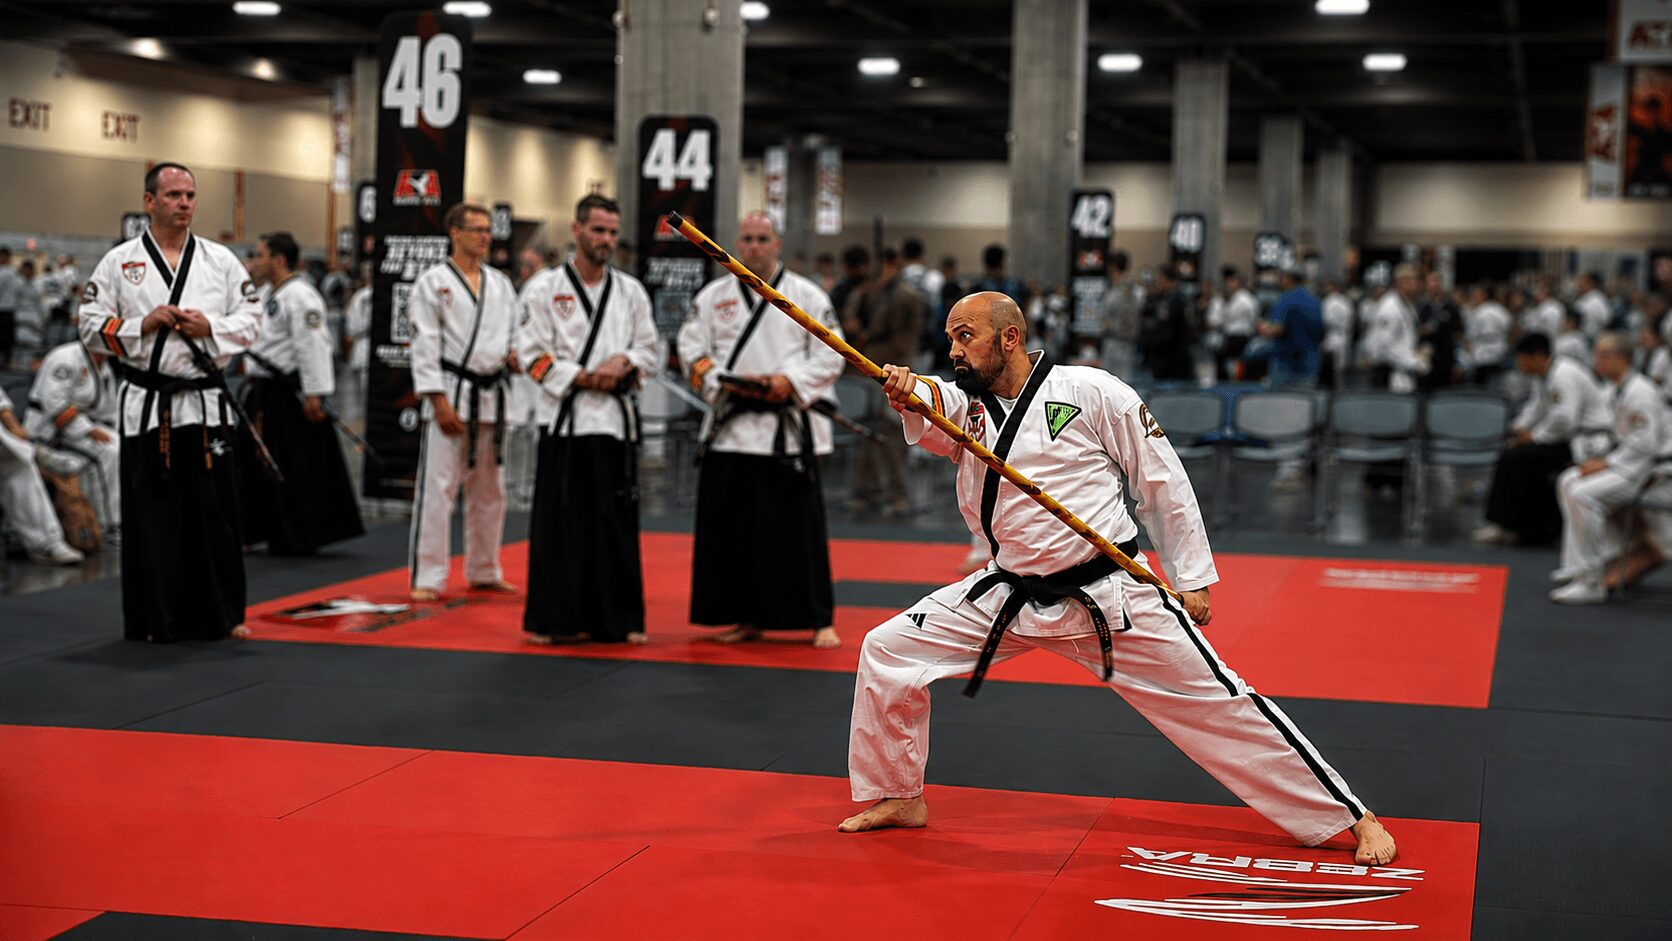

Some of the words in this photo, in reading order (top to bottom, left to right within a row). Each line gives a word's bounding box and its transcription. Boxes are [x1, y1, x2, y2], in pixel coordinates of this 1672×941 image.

[382, 33, 462, 128] 46
[9, 97, 50, 131] EXIT
[642, 129, 712, 190] 44
[1071, 195, 1112, 238] 42
[1127, 846, 1425, 880] ZEBRA
